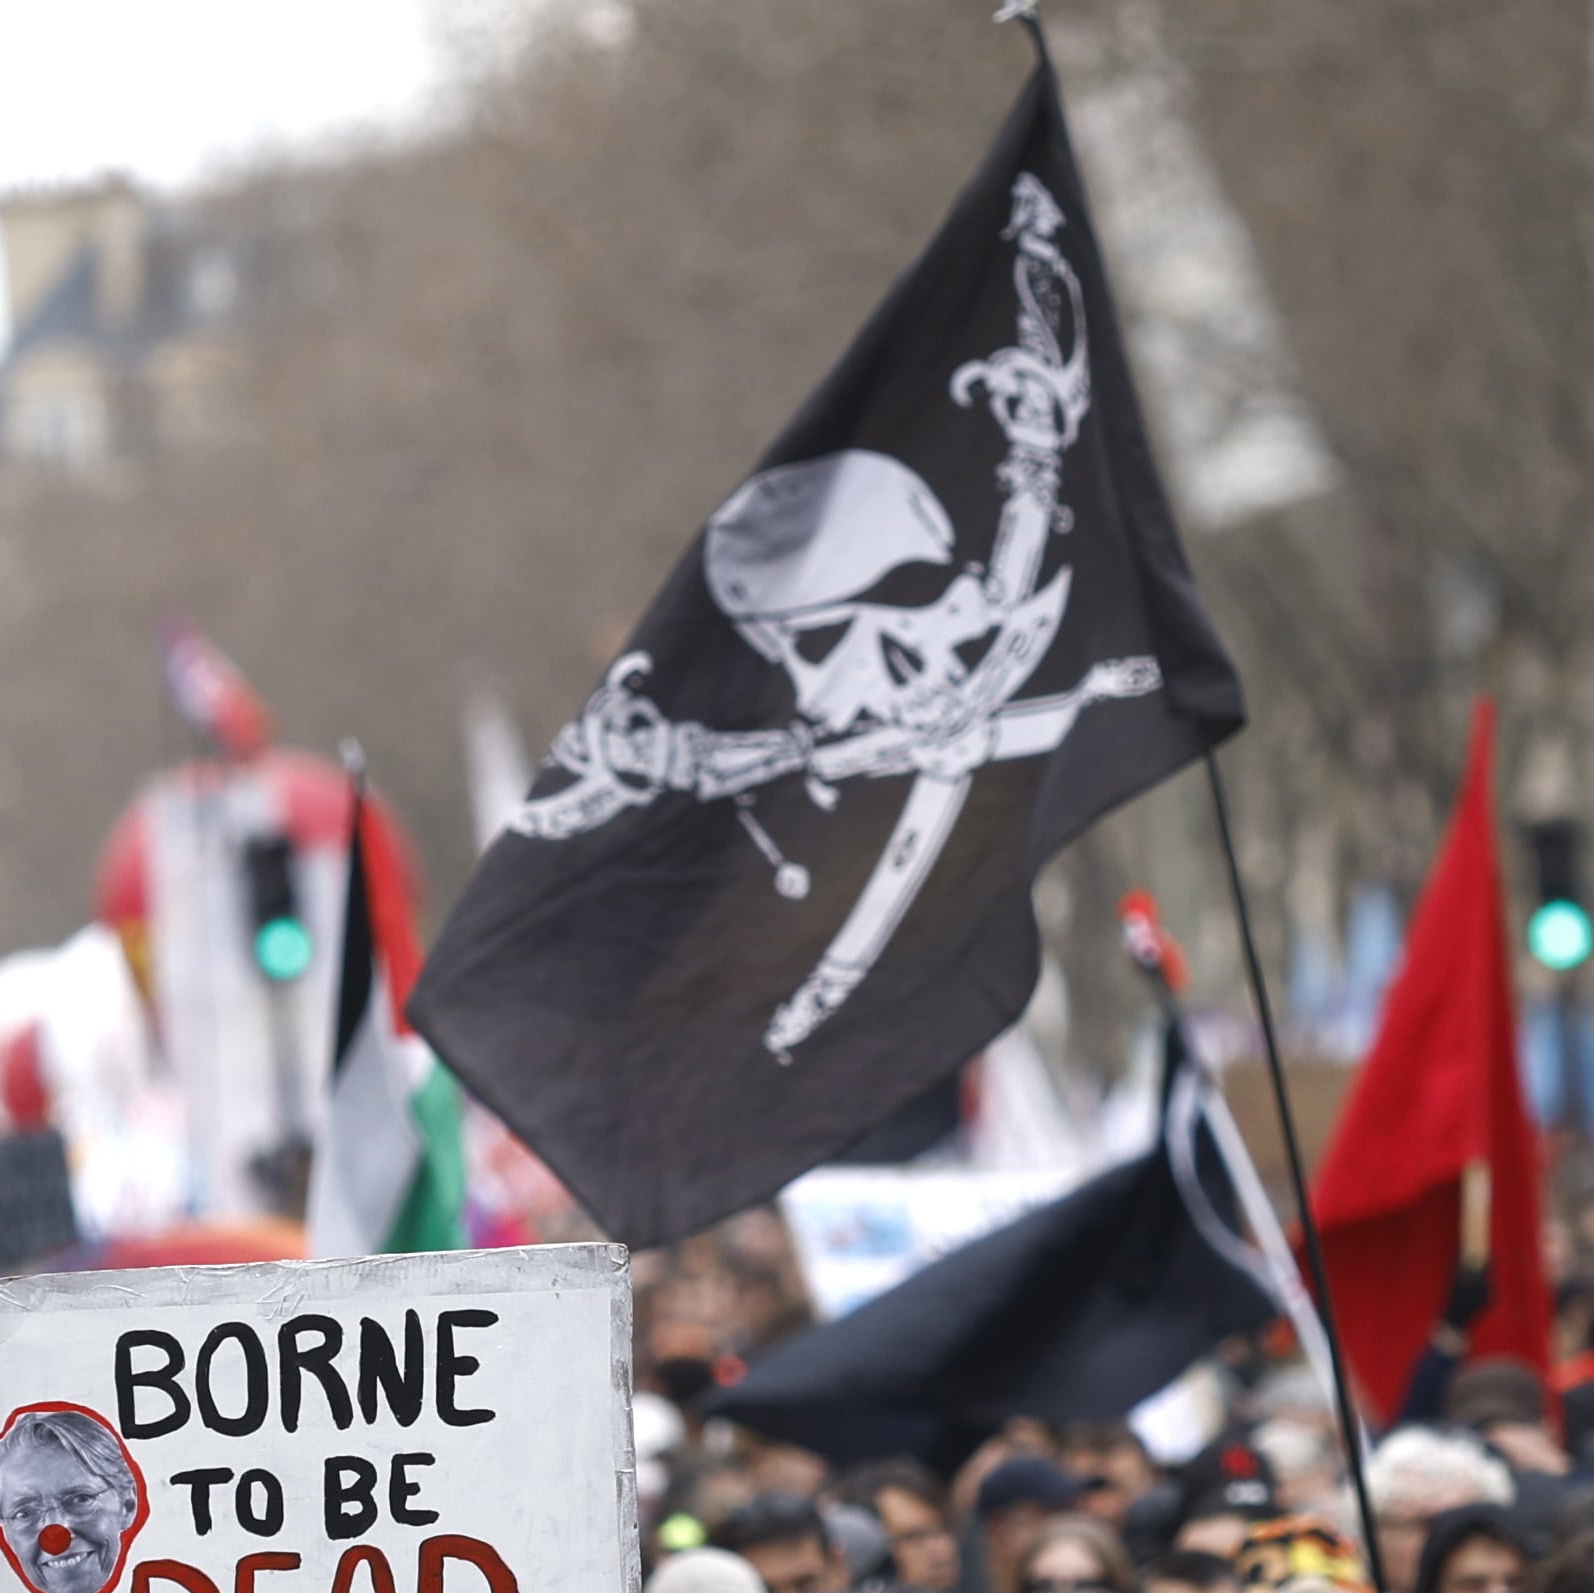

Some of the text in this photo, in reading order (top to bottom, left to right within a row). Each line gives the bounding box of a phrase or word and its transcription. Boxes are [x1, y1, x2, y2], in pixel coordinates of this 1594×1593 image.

[115, 1308, 499, 1440] BORNE
[170, 1452, 439, 1540] TO BE
